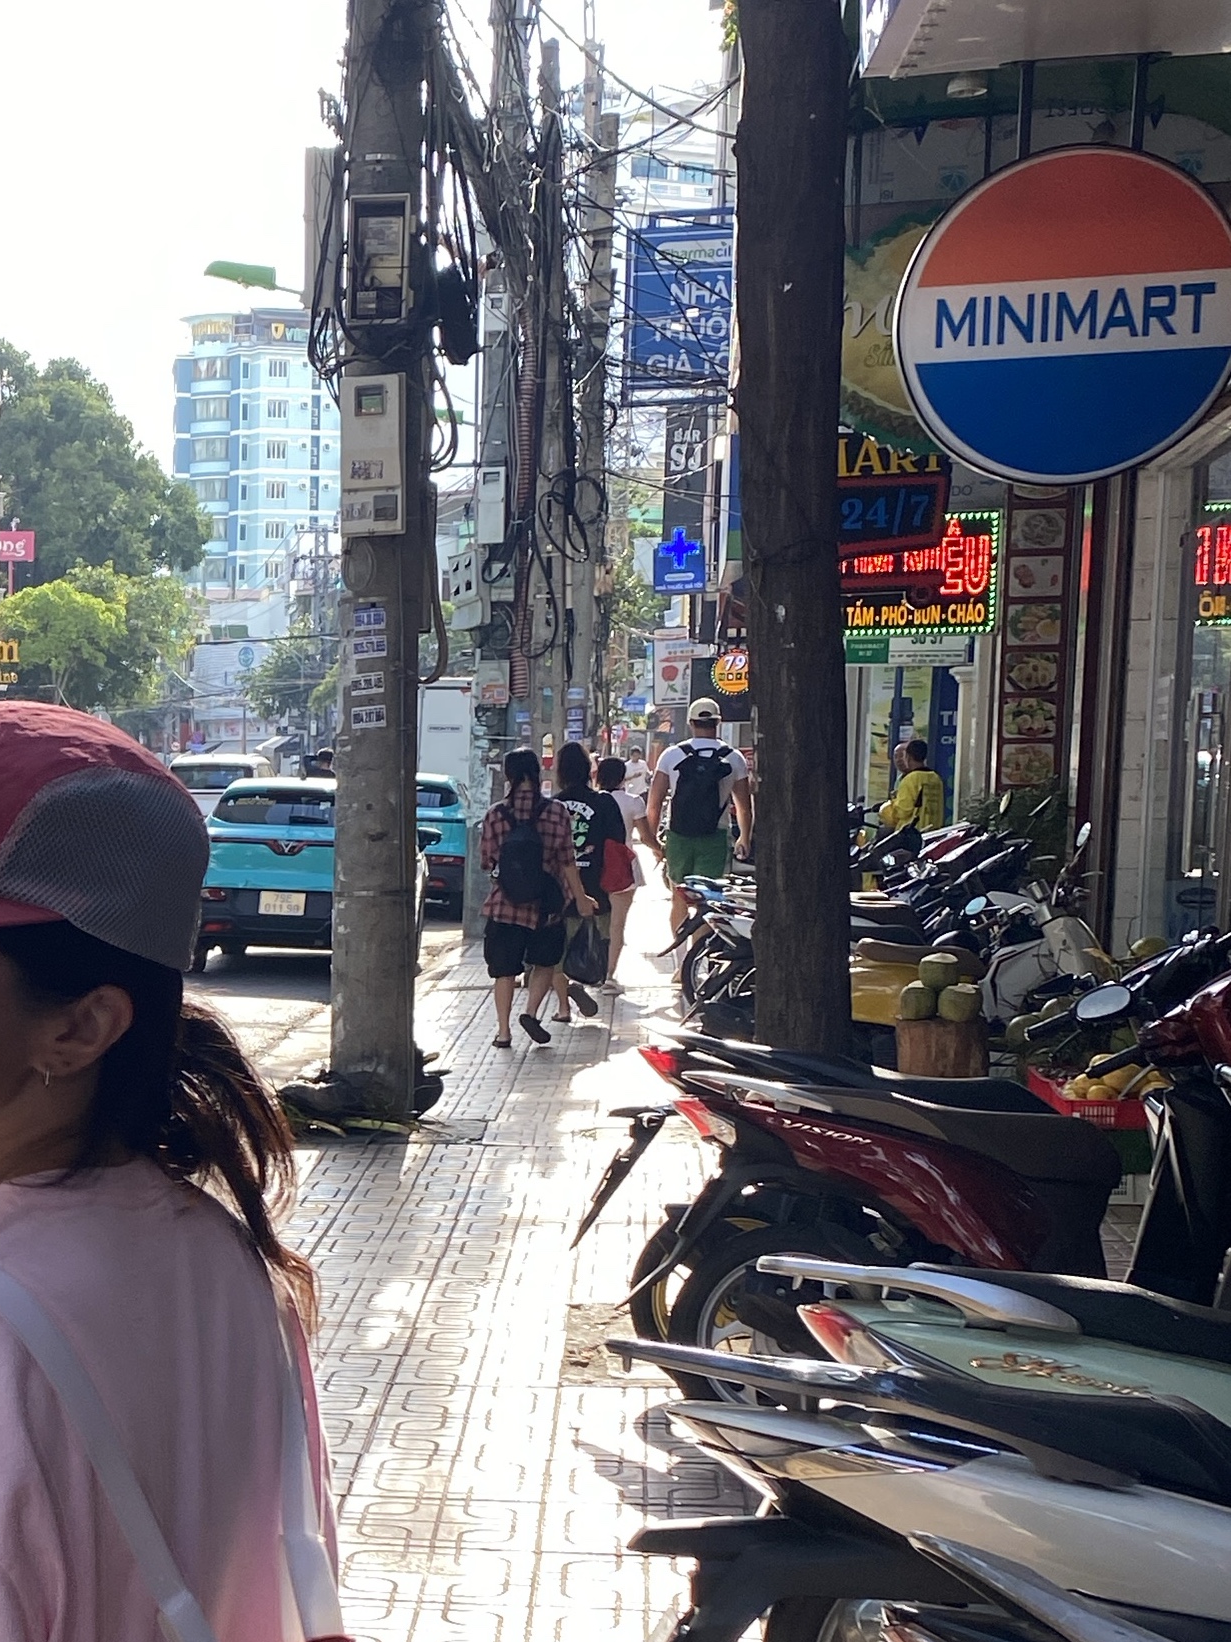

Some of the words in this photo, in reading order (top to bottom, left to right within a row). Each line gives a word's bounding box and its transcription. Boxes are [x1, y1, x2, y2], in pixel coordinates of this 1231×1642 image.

[934, 281, 1216, 349] MINIMART
[673, 427, 701, 443] BAR
[841, 488, 930, 535] 24/7
[724, 655, 747, 672] 79
